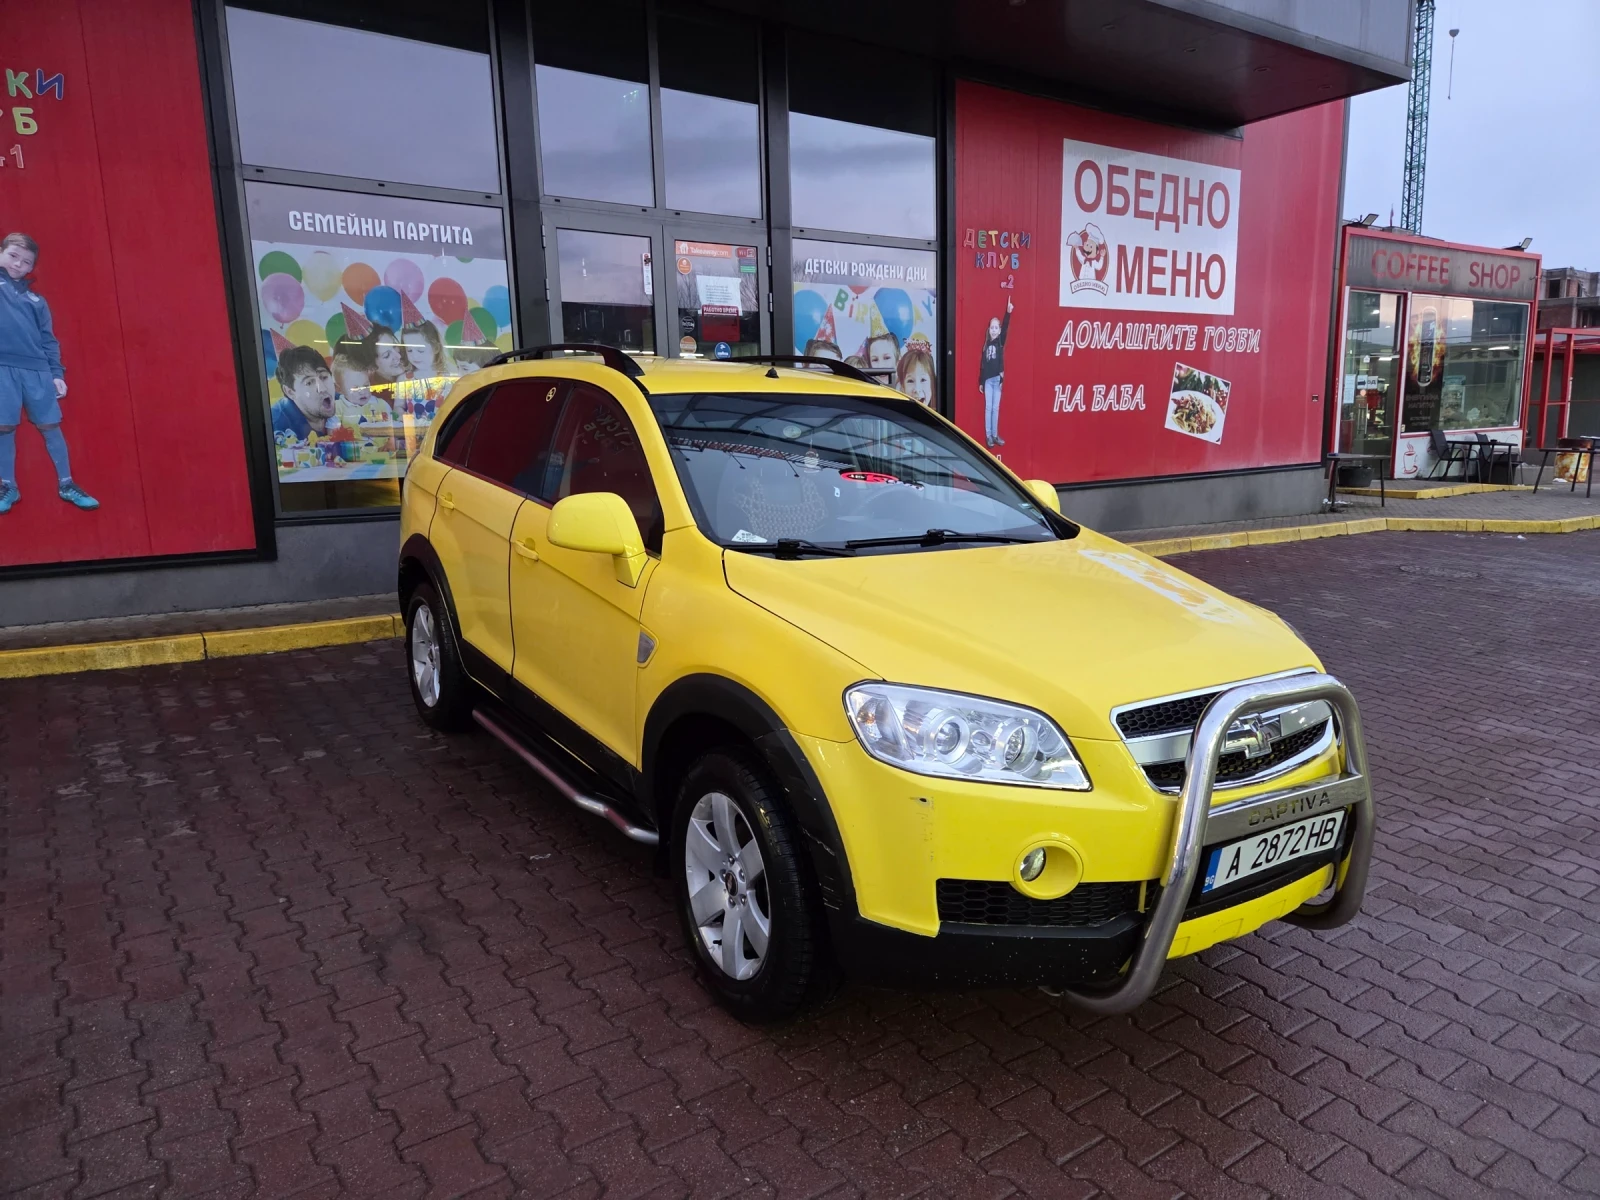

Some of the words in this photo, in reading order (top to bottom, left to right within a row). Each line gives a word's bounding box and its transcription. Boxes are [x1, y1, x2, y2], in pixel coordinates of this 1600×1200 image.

[1074, 159, 1231, 234] ОБЕДНО
[288, 210, 388, 238] СЕМЕЙНИ
[393, 219, 473, 246] ПАРТИТА
[963, 228, 1031, 249] ДЕТСКИ
[804, 258, 848, 276] ДЕТСКИ
[851, 262, 903, 280] РОЖДЕНИ
[906, 266, 928, 282] ДНИ
[975, 251, 1020, 270] КЛУБ
[1115, 244, 1226, 300] МЕНЮ
[1371, 249, 1450, 285] COFFEE
[1468, 261, 1521, 290] SHOP
[1055, 320, 1198, 356] ДОМАШНИТЕ
[1202, 326, 1261, 353] ГОЗБИ
[1053, 384, 1086, 413] НА
[1091, 384, 1146, 411] БАБА
[1248, 791, 1331, 827] CAPTIVA
[1225, 846, 1241, 880] A
